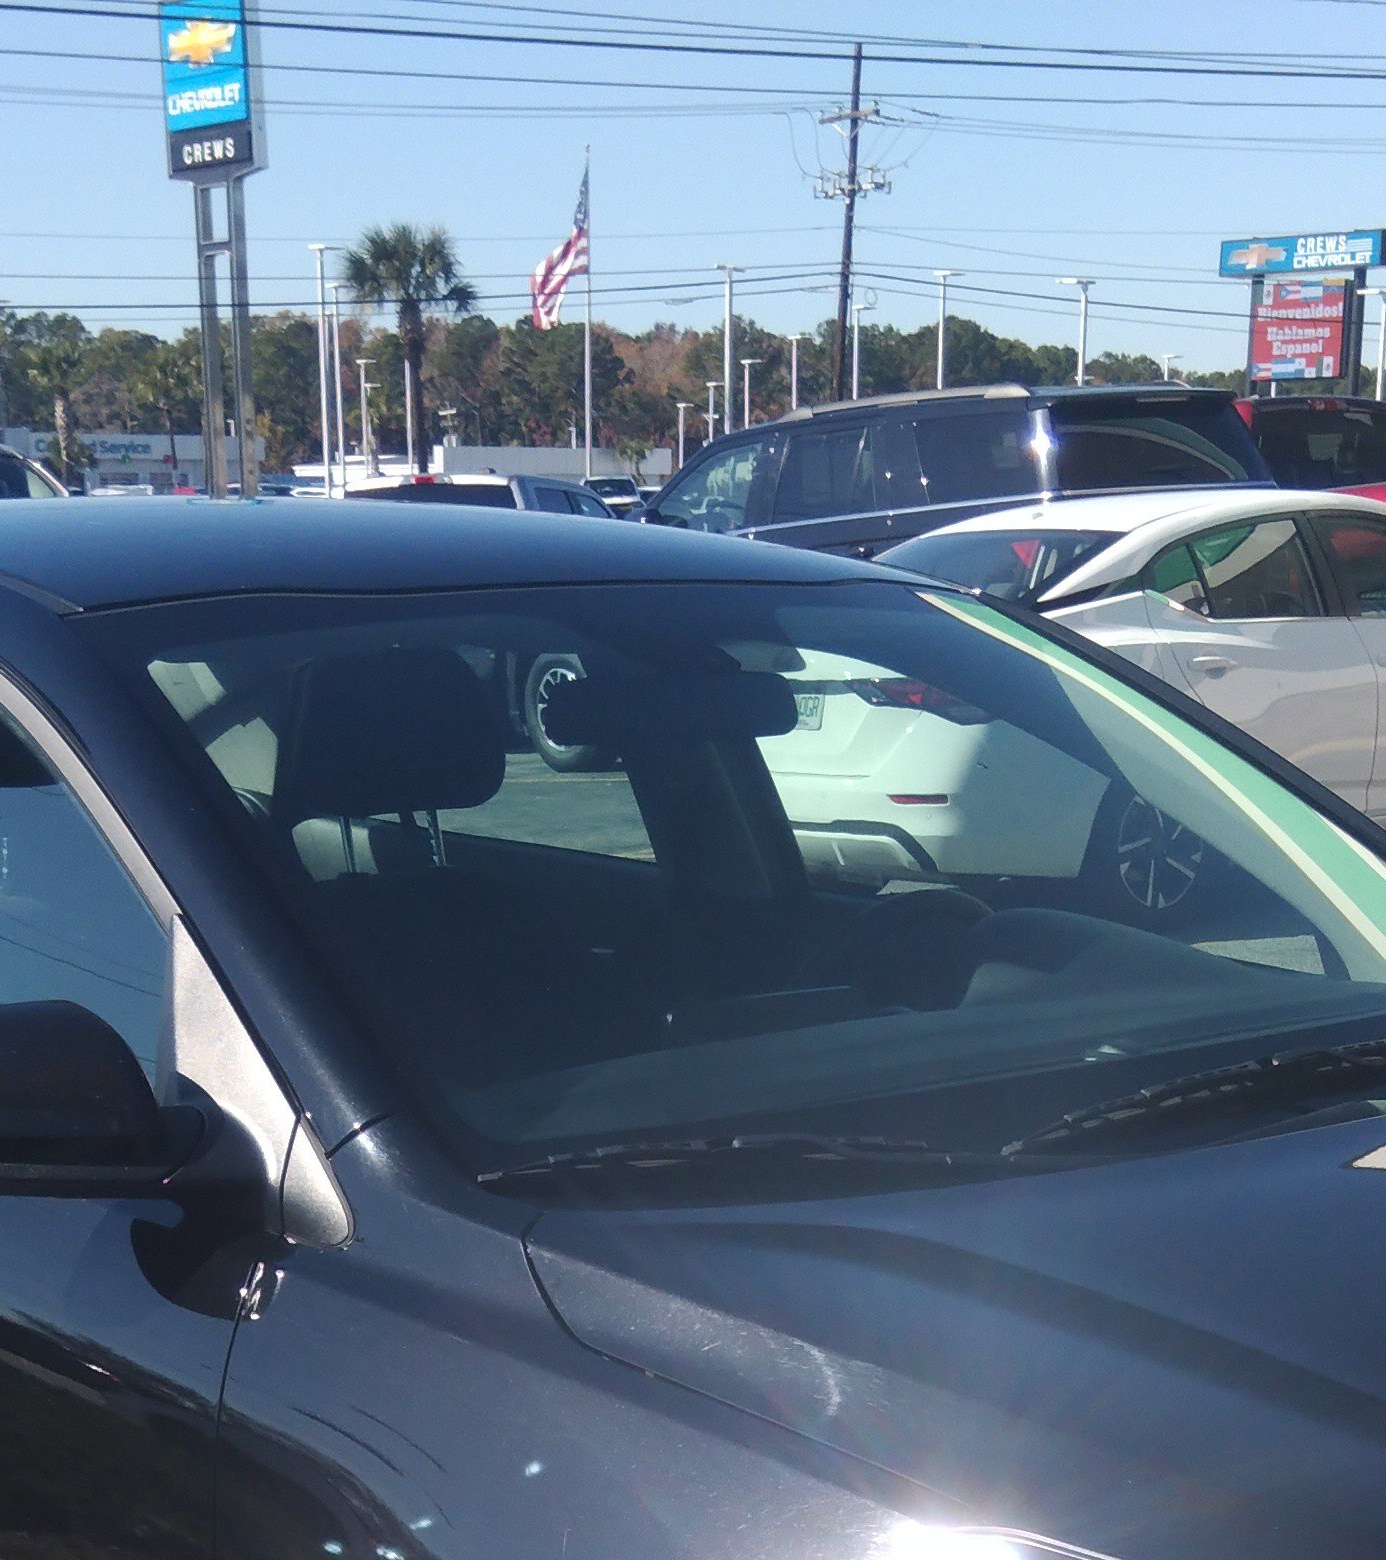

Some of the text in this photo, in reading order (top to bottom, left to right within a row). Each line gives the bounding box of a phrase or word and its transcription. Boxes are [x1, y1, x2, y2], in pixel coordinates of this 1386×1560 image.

[168, 83, 241, 115] CHEVROLET
[183, 137, 235, 164] CREWS
[1296, 235, 1347, 254] CREWS
[1293, 251, 1373, 269] CHEVROLET
